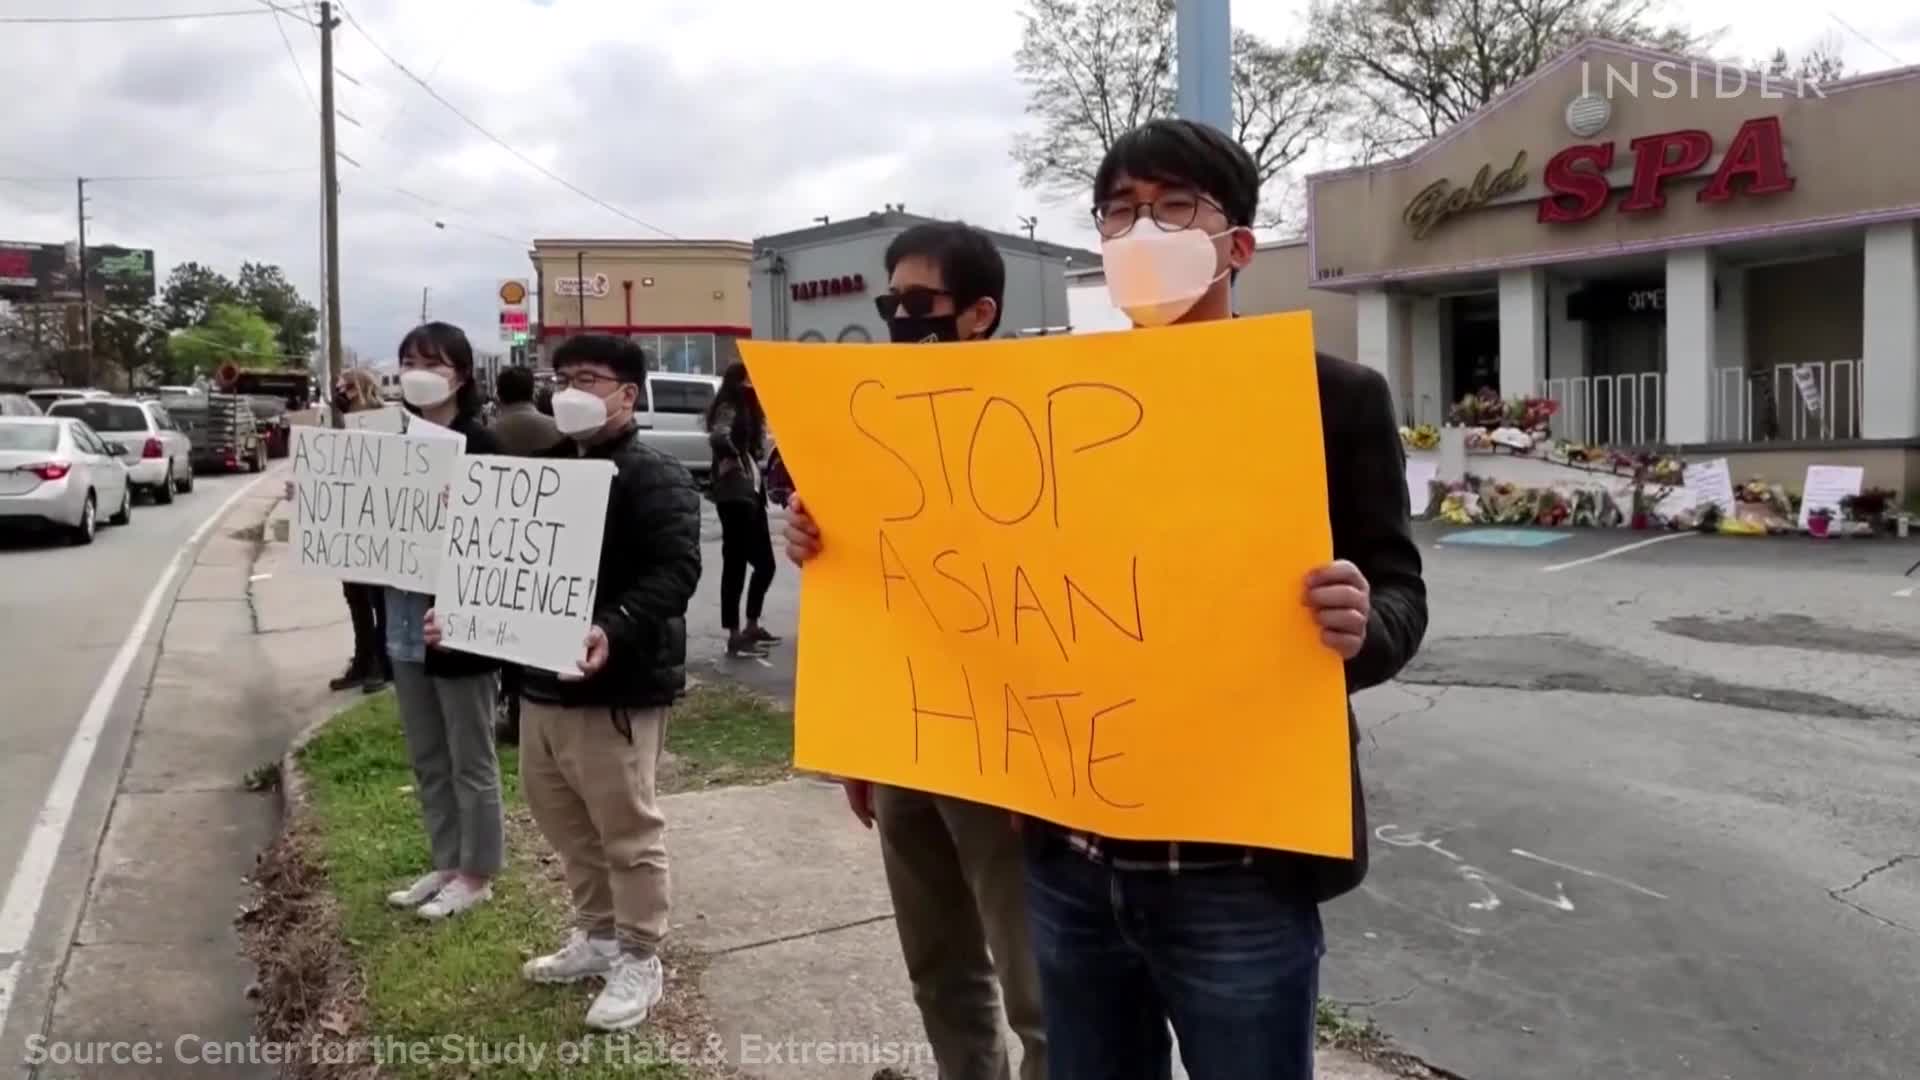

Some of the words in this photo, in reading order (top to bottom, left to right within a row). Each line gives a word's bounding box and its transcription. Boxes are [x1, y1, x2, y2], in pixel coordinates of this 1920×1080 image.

[1403, 150, 1529, 240] Gold
[1537, 116, 1797, 225] SPA
[1627, 288, 1666, 311] OPE
[293, 432, 382, 478] ASIAN
[402, 439, 430, 476] IS
[849, 379, 1143, 528] STOP
[298, 479, 354, 528] NOT
[358, 485, 375, 527] A
[462, 461, 561, 517] STOP
[302, 529, 390, 571] RACISM
[449, 516, 566, 566] RACIST
[457, 564, 596, 622] VIOLENCE!
[879, 528, 1144, 663] ASIAN
[906, 655, 1144, 809] HATE
